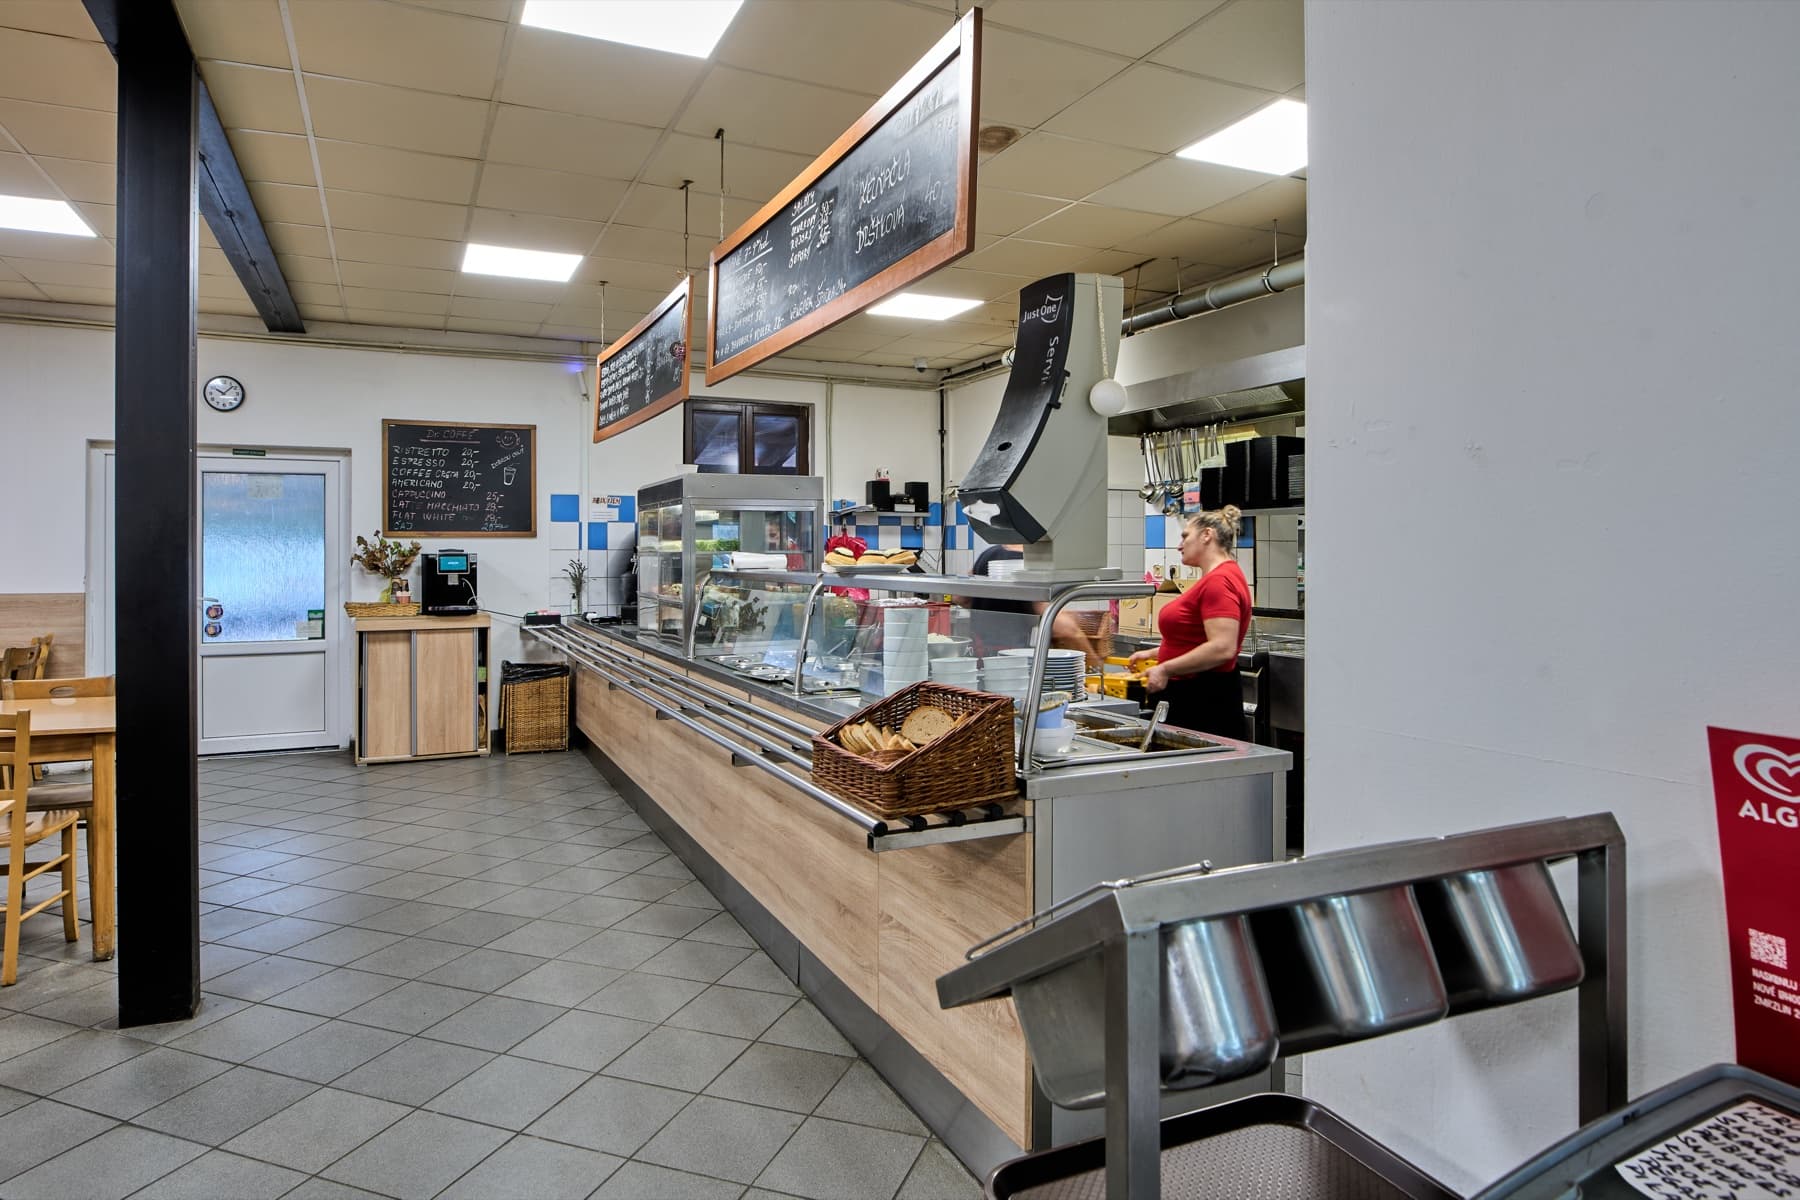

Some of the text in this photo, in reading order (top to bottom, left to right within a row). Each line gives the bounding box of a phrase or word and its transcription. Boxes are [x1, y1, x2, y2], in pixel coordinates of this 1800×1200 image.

[392, 456, 446, 468] ESPRESSO
[391, 467, 433, 478] COFFEE
[391, 478, 444, 489] AMERICANO
[392, 510, 417, 520] FLAT
[422, 512, 457, 521] WHITE
[1738, 799, 1800, 828] ALG
